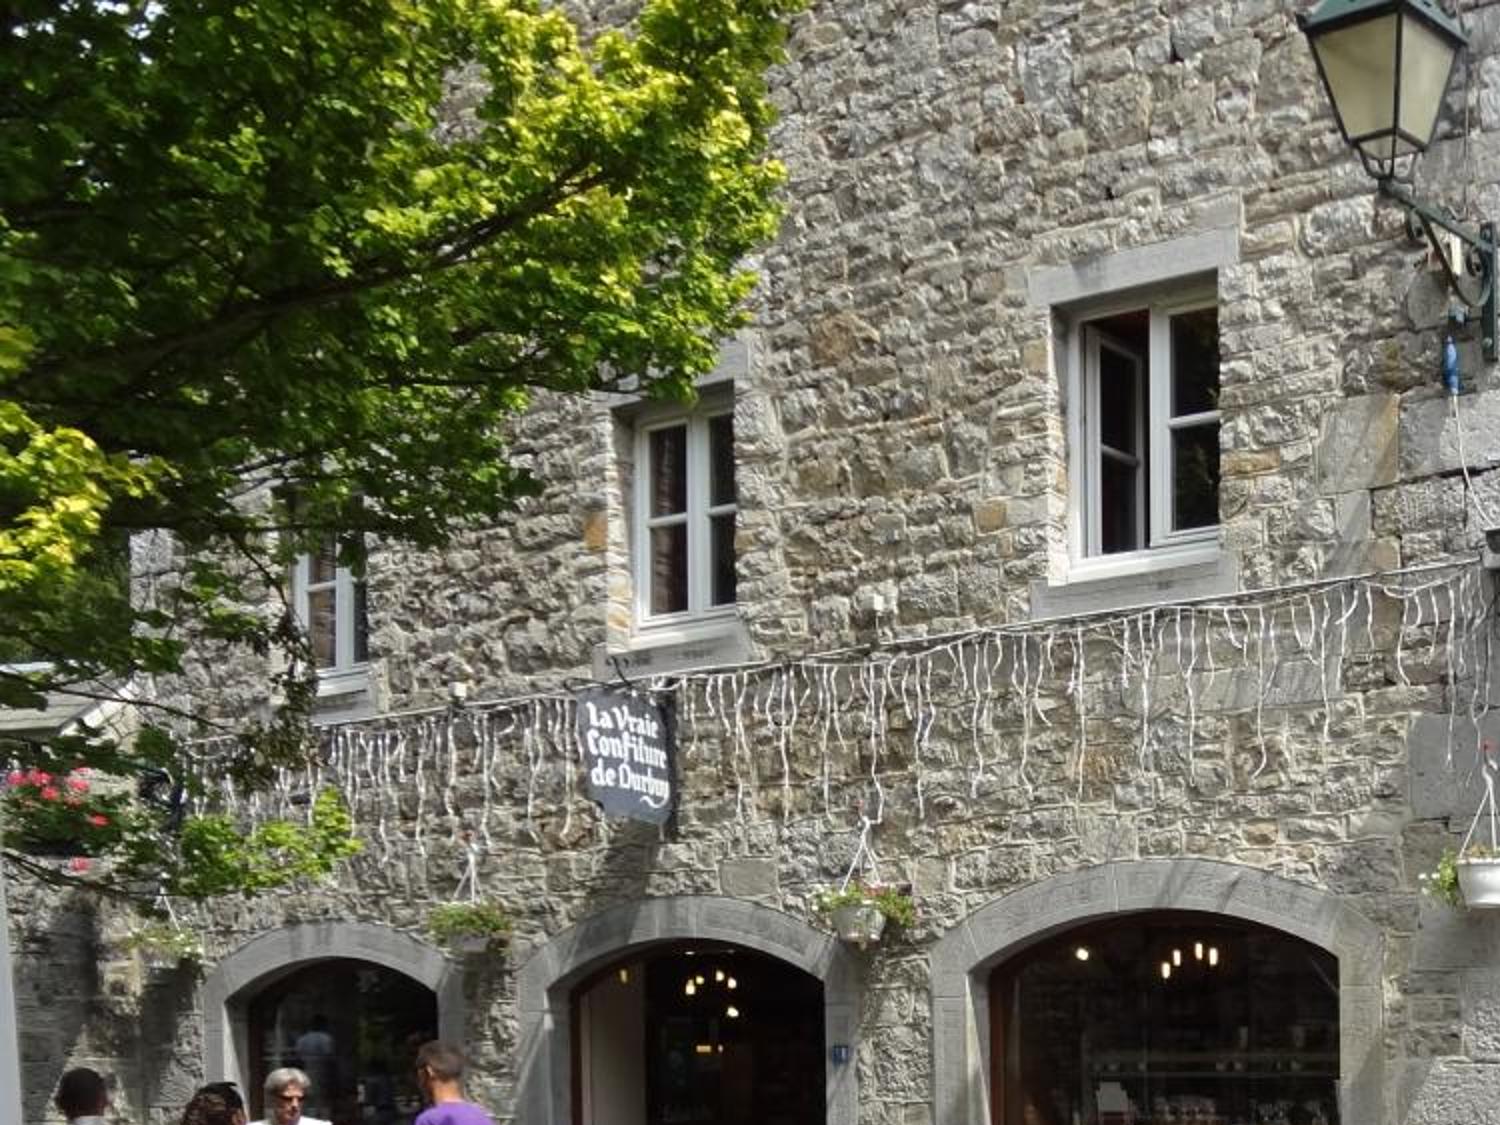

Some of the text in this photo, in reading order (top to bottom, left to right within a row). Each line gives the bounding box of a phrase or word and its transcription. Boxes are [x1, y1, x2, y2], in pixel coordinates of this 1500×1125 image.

[586, 701, 659, 739] La Vraie
[586, 728, 667, 769] Confiture
[590, 758, 671, 809] de Durbuy
